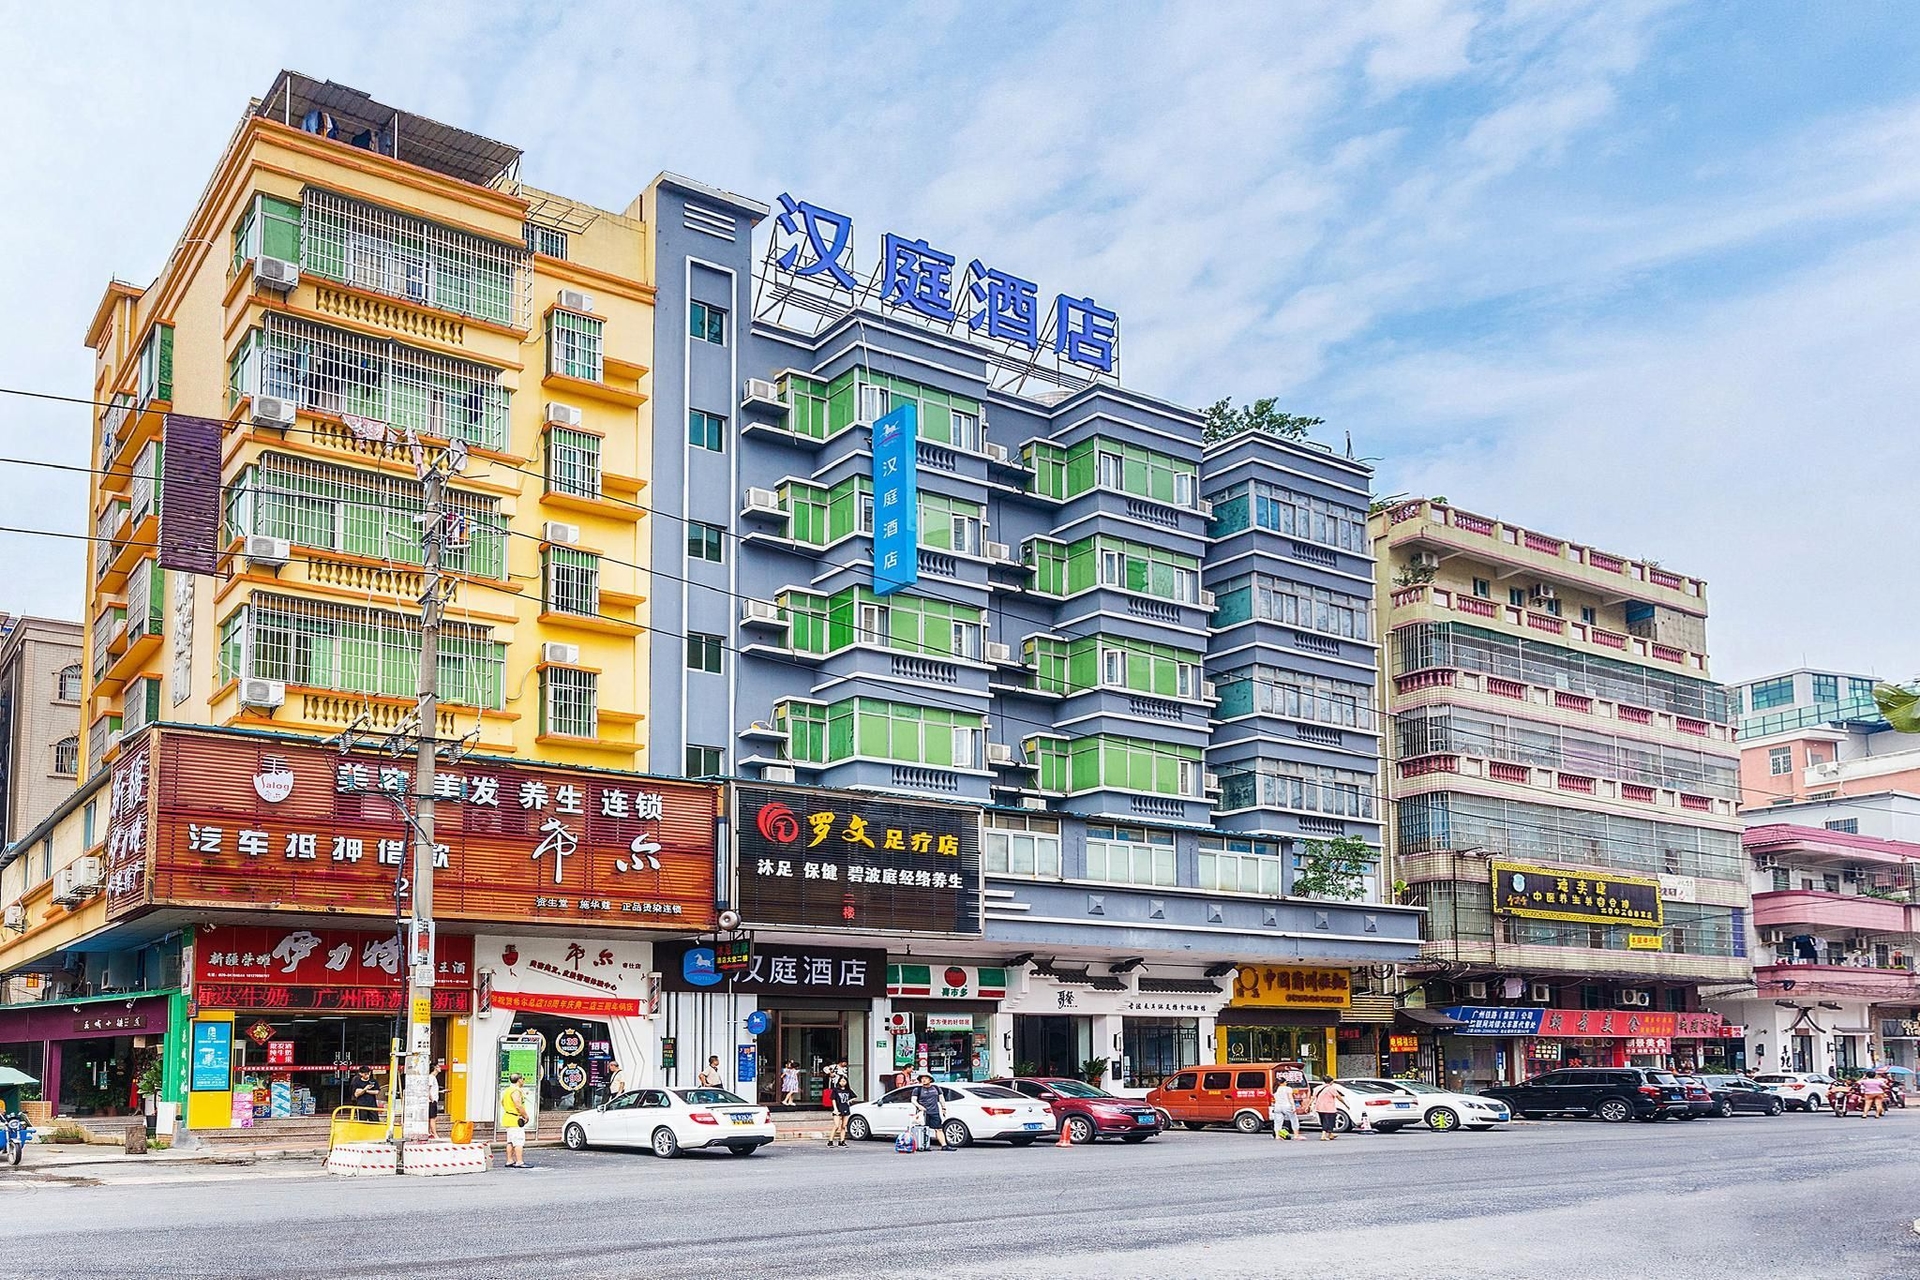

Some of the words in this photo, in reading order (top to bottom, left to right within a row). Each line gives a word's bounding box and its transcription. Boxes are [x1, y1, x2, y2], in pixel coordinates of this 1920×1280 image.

[776, 192, 1116, 372] 汉庭酒店
[883, 456, 898, 571] 汉庭酒店
[519, 781, 585, 815] 养生
[601, 789, 664, 821] 连锁
[756, 858, 794, 878] 沐足
[803, 861, 839, 881] 保健
[732, 954, 868, 987] 汉庭酒店
